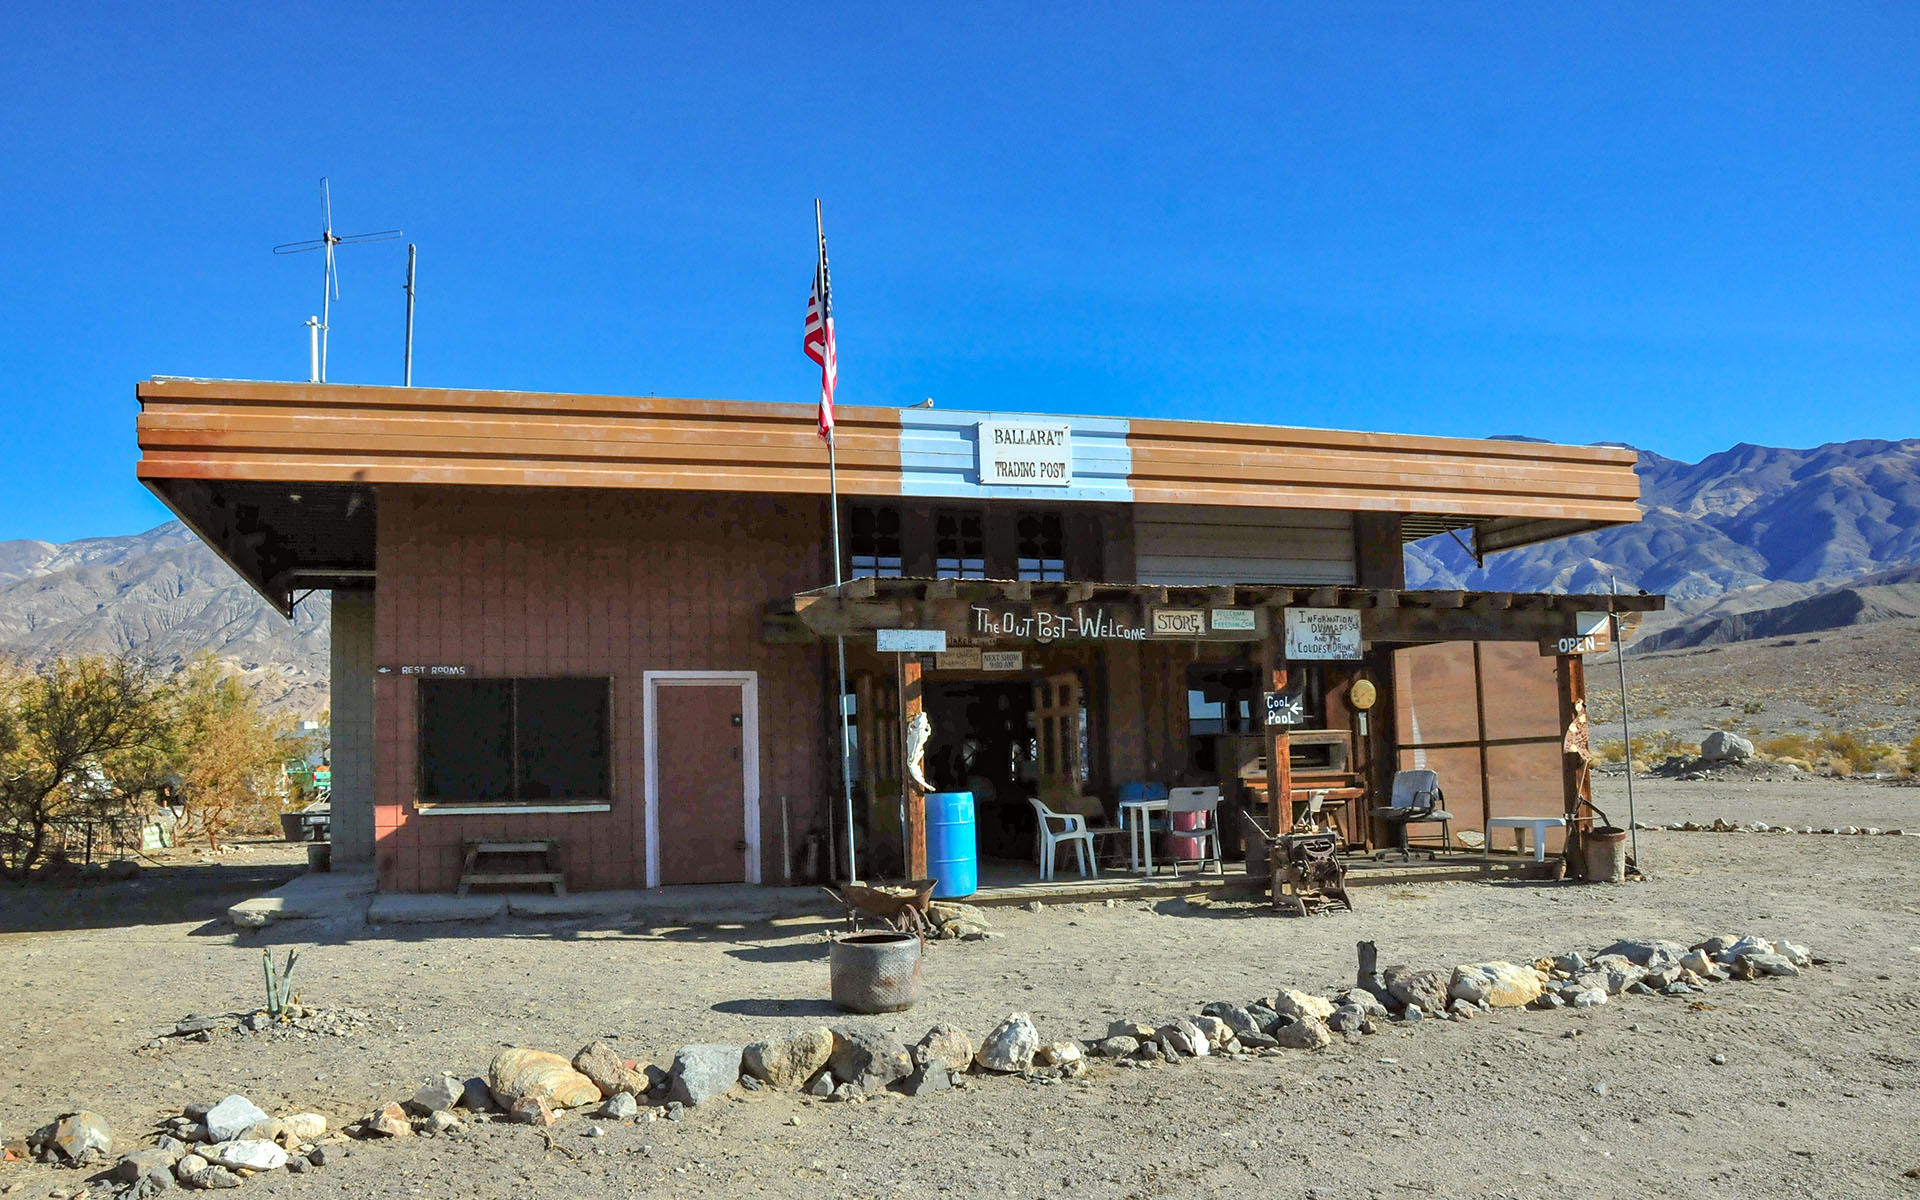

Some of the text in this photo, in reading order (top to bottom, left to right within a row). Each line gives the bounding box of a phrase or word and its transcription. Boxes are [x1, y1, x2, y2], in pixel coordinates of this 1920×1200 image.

[994, 429, 1064, 446] BALLARAT
[994, 461, 1066, 478] TRADING POST
[1158, 614, 1199, 632] STORE
[1299, 611, 1354, 623] INFORMATION
[1297, 642, 1331, 654] COLDEST
[1559, 637, 1595, 653] OPEN
[402, 666, 466, 675] REST ROOMS
[1268, 710, 1294, 725] POOL
